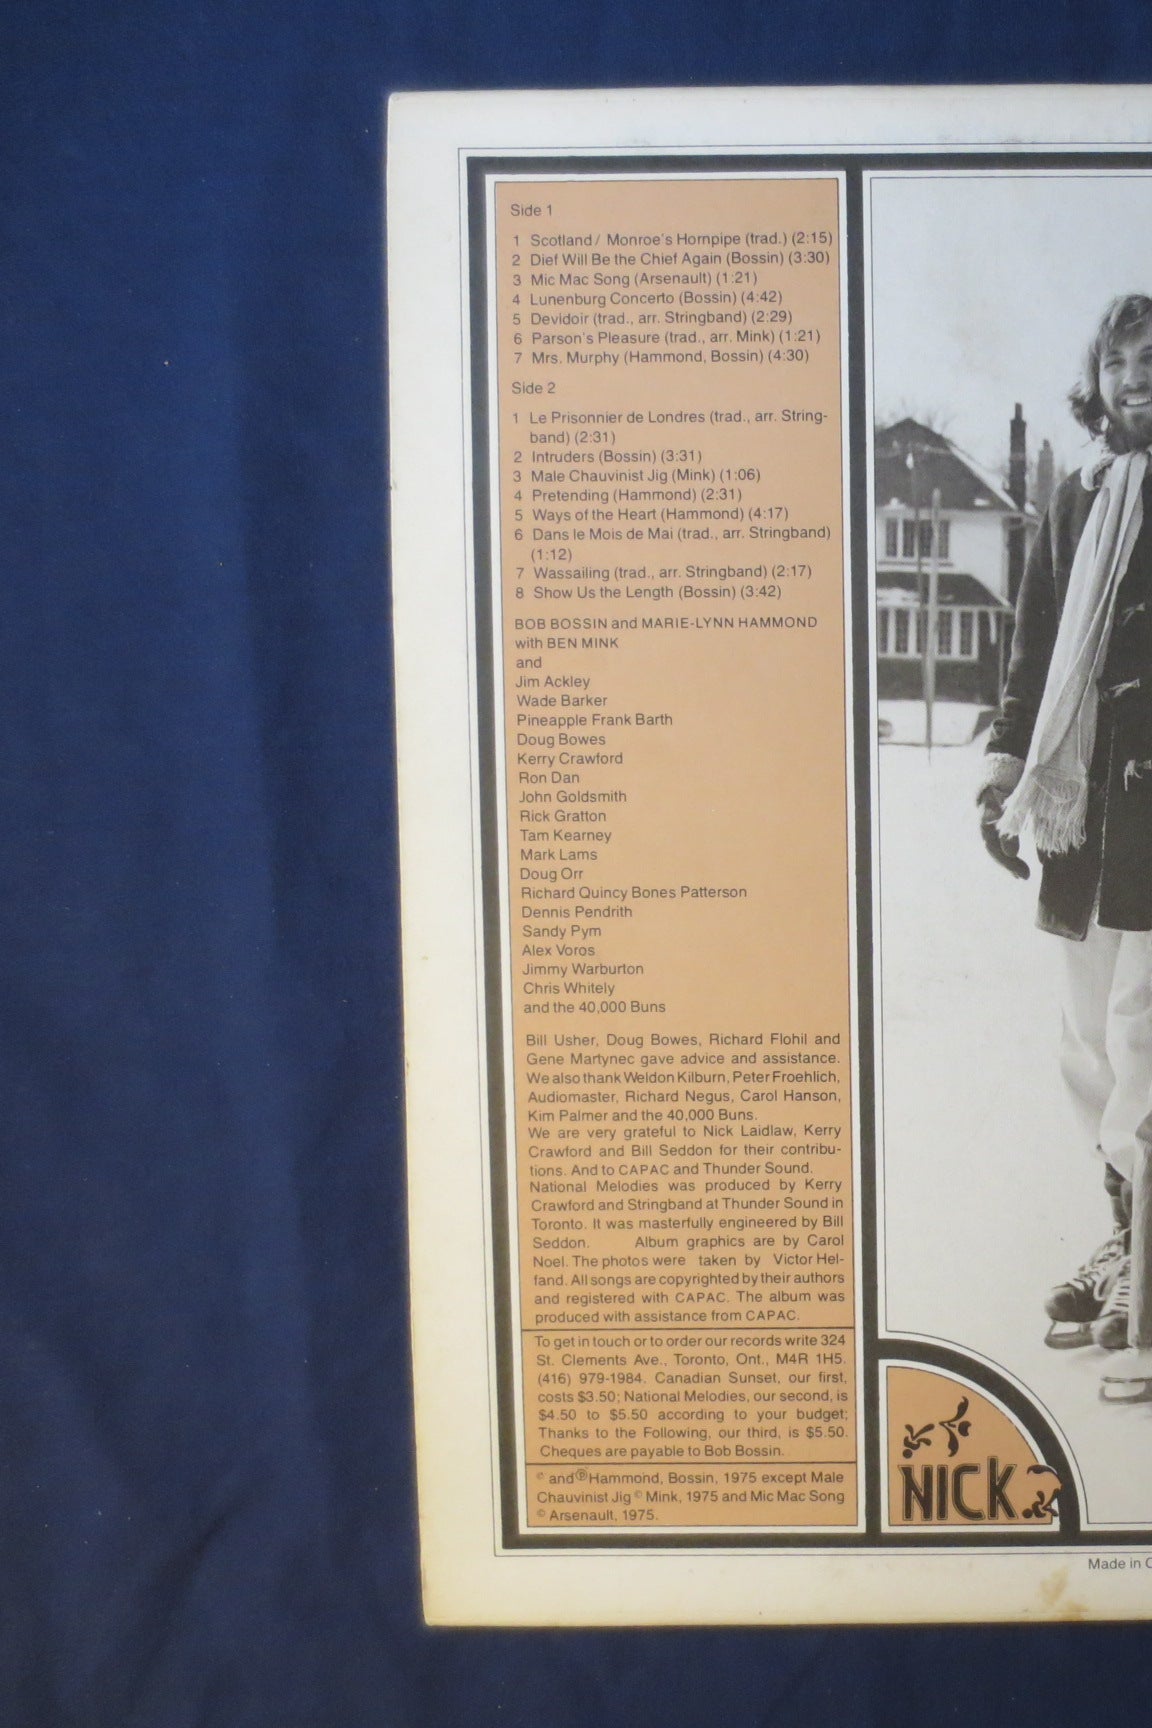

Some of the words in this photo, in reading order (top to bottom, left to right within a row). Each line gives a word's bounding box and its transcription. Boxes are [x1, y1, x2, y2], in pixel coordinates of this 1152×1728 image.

[510, 202, 542, 217] Side
[546, 203, 552, 216] 1
[512, 234, 519, 247] 1
[530, 232, 601, 248] Scotland/
[606, 232, 673, 247] Monroe's
[676, 231, 741, 249] Hornpipe
[744, 231, 788, 248] (trad.)
[789, 230, 833, 248] (2:15)
[511, 253, 521, 267] 2
[529, 252, 559, 267] Dief
[561, 252, 588, 267] Will
[591, 252, 611, 267] Be
[613, 252, 636, 266] the
[639, 250, 679, 267] Chief
[680, 251, 722, 269] Again
[725, 249, 784, 268] (Bossin)
[787, 249, 830, 267] (3:30)
[512, 273, 522, 287] 3
[530, 272, 556, 287] Mic
[558, 271, 589, 287] Mac
[593, 271, 631, 289] Song
[633, 271, 712, 289] (Arsenault)
[715, 270, 758, 288] (1:21)
[511, 293, 521, 306] 4
[527, 291, 607, 309] Lunenburg
[609, 290, 675, 305] Concerto
[678, 289, 737, 307] (Bossin)
[740, 289, 783, 307] (4:42)
[511, 379, 544, 396] Side
[545, 380, 556, 395] 2
[512, 412, 518, 424] 1
[529, 411, 548, 425] Le
[551, 409, 623, 425] Prisonnier
[626, 410, 644, 424] de
[647, 408, 706, 424] Londres
[709, 409, 750, 426] (trad.,
[754, 410, 778, 423] arr.
[780, 407, 828, 426] String-
[529, 430, 571, 447] band)
[574, 429, 616, 447] (2:31)
[513, 450, 523, 464] 2
[531, 449, 595, 464] Intruders
[598, 448, 657, 466] (Bossin)
[660, 448, 702, 466] (3:31)
[512, 469, 522, 483] 3
[530, 469, 566, 485] Male
[567, 467, 644, 484] Chauvinist
[646, 468, 668, 485] Jig
[671, 466, 716, 485] (Mink)
[719, 466, 761, 485] (1:06)
[514, 508, 523, 522] 5
[531, 507, 571, 525] Ways
[574, 507, 589, 522] of
[591, 508, 614, 522] the
[617, 506, 658, 521] Heart
[660, 505, 745, 524] (Hammond)
[747, 505, 789, 523] (4:17)
[514, 586, 525, 600] 8
[533, 585, 573, 600] Show
[576, 585, 597, 599] Us
[599, 585, 622, 599] the
[625, 584, 674, 602] Length
[678, 582, 737, 601] (Bossin)
[739, 584, 782, 601] (3:42)
[514, 617, 546, 631] BOB
[549, 617, 608, 631] BOSSIN
[610, 616, 639, 631] and
[641, 616, 735, 630] MARIE-LYNN
[737, 615, 818, 631] HAMMOND
[514, 635, 544, 650] with
[546, 635, 578, 650] BEN
[581, 636, 619, 649] MINK
[514, 675, 540, 689] Jim
[543, 674, 591, 691] Ackley
[515, 693, 557, 708] Wade
[560, 692, 608, 708] Barker
[516, 712, 588, 731] Pineapple
[591, 712, 632, 727] Frank
[634, 711, 673, 726] Barth
[516, 751, 556, 769] Kerry
[558, 751, 624, 766] Crawford
[518, 789, 552, 804] John
[555, 789, 627, 804] Goldsmith
[519, 828, 550, 842] Tam
[552, 828, 612, 845] Kearney
[520, 885, 576, 900] Richard
[576, 885, 629, 903] Quincy
[631, 885, 677, 900] Bones
[677, 884, 748, 899] Patterson
[521, 962, 568, 979] Jimmy
[570, 961, 644, 976] Warburton
[522, 980, 561, 995] Chris
[563, 980, 616, 998] Whitely
[523, 1000, 550, 1014] and
[552, 1000, 575, 1014] the
[578, 999, 627, 1015] 40,000
[630, 999, 666, 1014] Buns
[525, 1033, 548, 1047] Bill
[553, 1033, 599, 1048] Usher,
[606, 1032, 644, 1050] Doug
[650, 1032, 702, 1048] Bowes,
[708, 1032, 764, 1046] Richard
[770, 1032, 811, 1046] Flohil
[814, 1032, 841, 1046] and
[526, 1051, 565, 1066] Gene
[570, 1051, 635, 1069] Martynec
[639, 1054, 675, 1068] gave
[679, 1051, 725, 1065] advice
[730, 1050, 757, 1065] and
[762, 1050, 841, 1065] assistance.
[527, 1109, 555, 1123] Kim
[558, 1108, 609, 1122] Palmer
[611, 1108, 638, 1122] and
[640, 1108, 663, 1122] the
[666, 1107, 715, 1123] 40,000
[717, 1107, 758, 1121] Buns.
[534, 1310, 600, 1326] produced
[602, 1310, 631, 1323] with
[633, 1309, 708, 1323] assistance
[710, 1308, 742, 1322] from
[745, 1308, 800, 1322] CAPAC.
[536, 1353, 555, 1367] St.
[561, 1352, 627, 1367] Clements
[632, 1353, 668, 1367] Ave.,
[672, 1352, 729, 1367] Toronto,
[735, 1352, 769, 1367] Ont.,
[775, 1352, 809, 1366] M4R
[815, 1351, 846, 1365] 1H5.
[537, 1371, 572, 1388] (416)
[578, 1371, 647, 1385] 979-1984.
[654, 1371, 721, 1385] Canadian
[728, 1370, 783, 1385] Sunset,
[788, 1373, 812, 1384] our
[818, 1369, 847, 1385] first,
[539, 1444, 602, 1460] Cheques
[604, 1447, 628, 1458] are
[630, 1444, 685, 1460] payable
[687, 1445, 701, 1457] to
[703, 1444, 732, 1457] Bob
[734, 1443, 785, 1457] Bossin.
[898, 1456, 1018, 1521] NICK
[1087, 1557, 1127, 1571] Made
[1129, 1556, 1142, 1569] in
